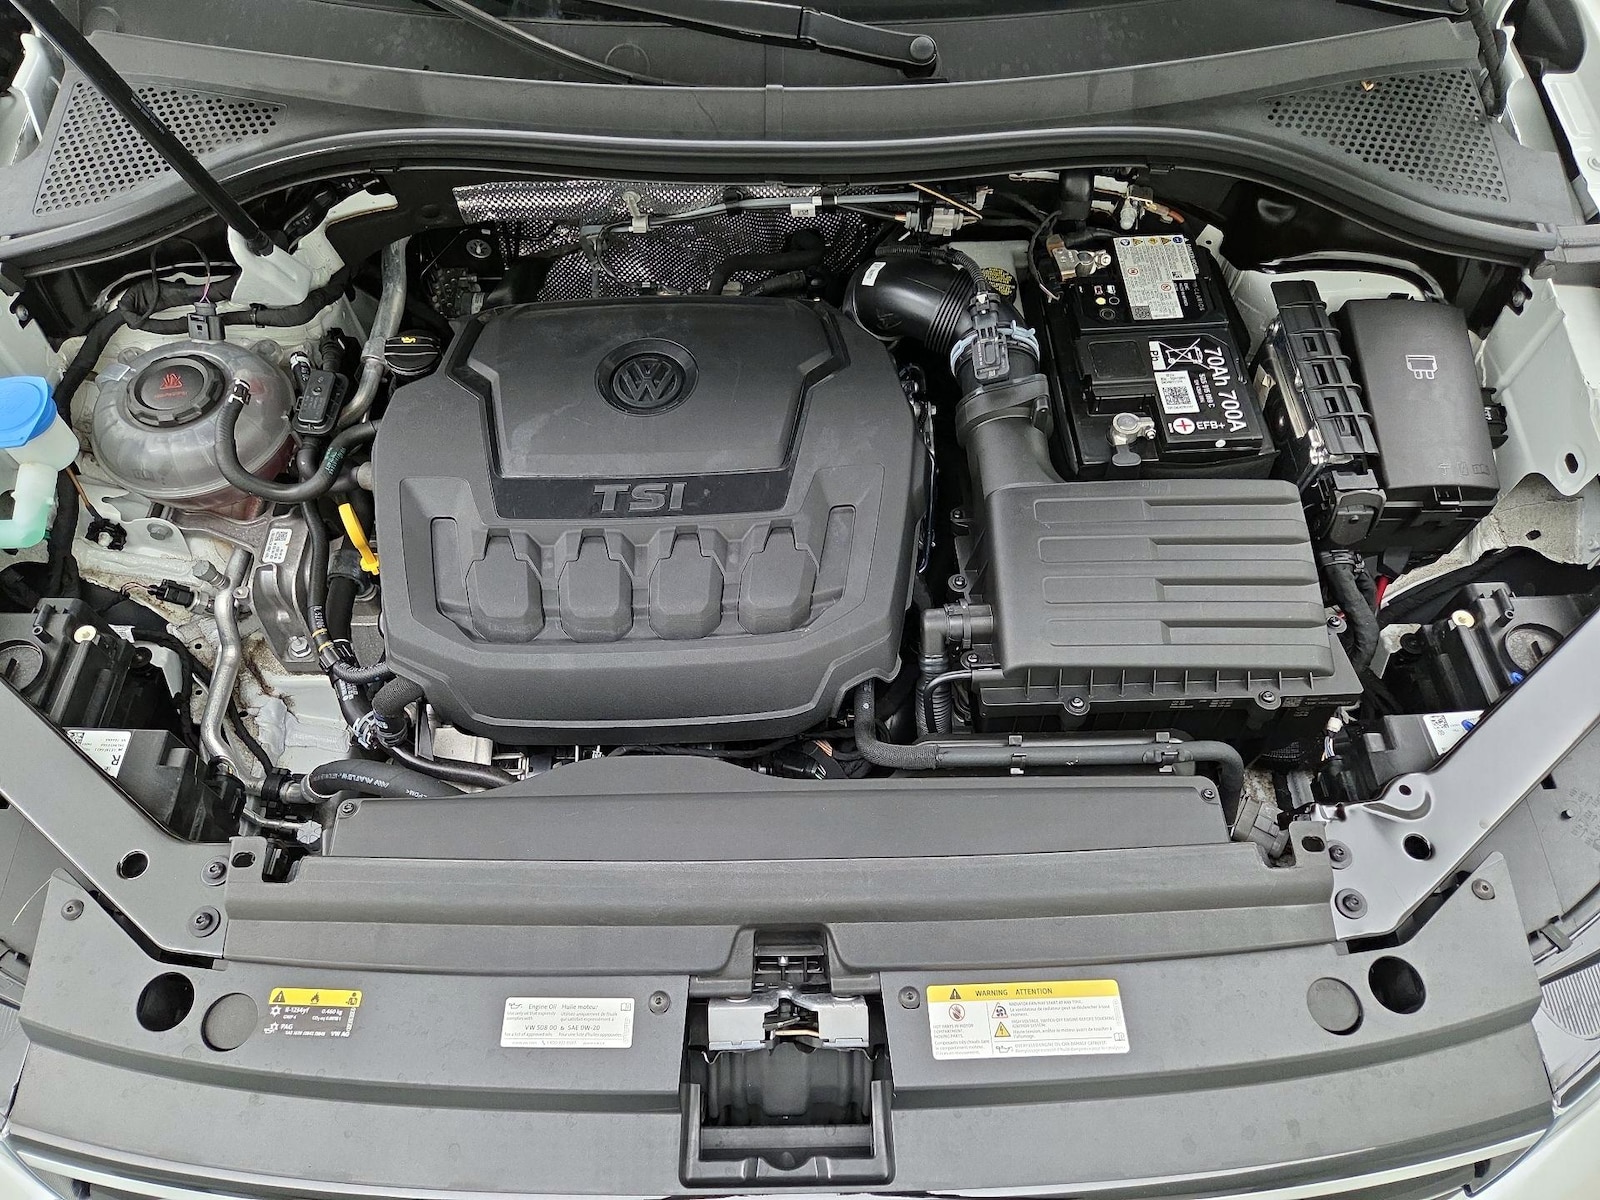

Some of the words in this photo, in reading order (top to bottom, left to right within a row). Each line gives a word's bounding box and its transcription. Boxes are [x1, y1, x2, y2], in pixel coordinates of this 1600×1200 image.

[1204, 346, 1231, 386] 70Ah
[1218, 390, 1247, 432] 700A
[1196, 420, 1225, 430] EFB+
[593, 482, 687, 512] TSI
[111, 754, 121, 766] R
[975, 989, 1008, 997] WARNING
[528, 1003, 548, 1011] Engine
